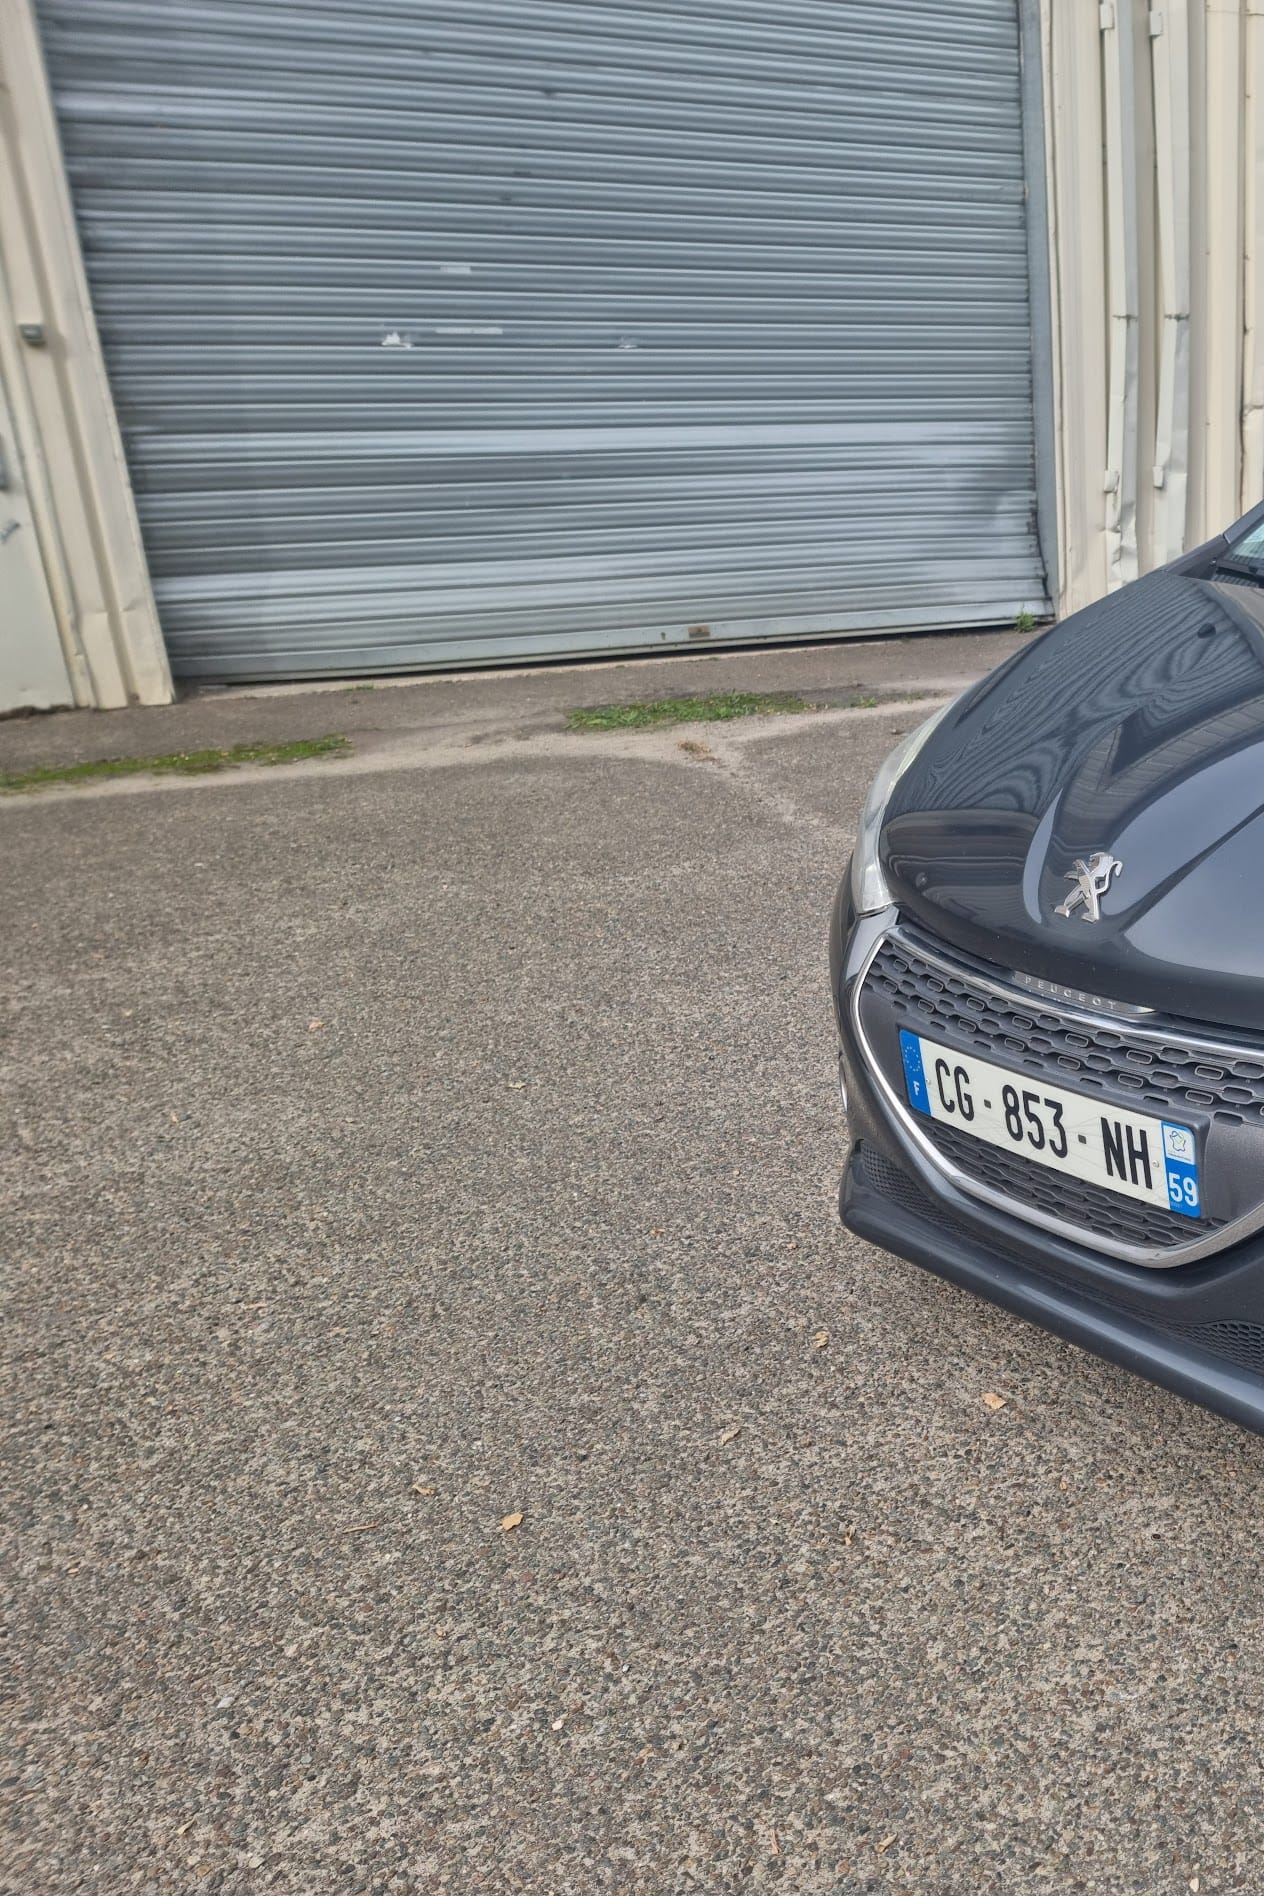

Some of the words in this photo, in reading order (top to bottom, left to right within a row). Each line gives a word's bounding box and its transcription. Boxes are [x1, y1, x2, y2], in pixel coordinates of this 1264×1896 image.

[1024, 975, 1116, 1010] PEUGEOT
[913, 1080, 920, 1096] F
[1168, 1171, 1199, 1207] 59
